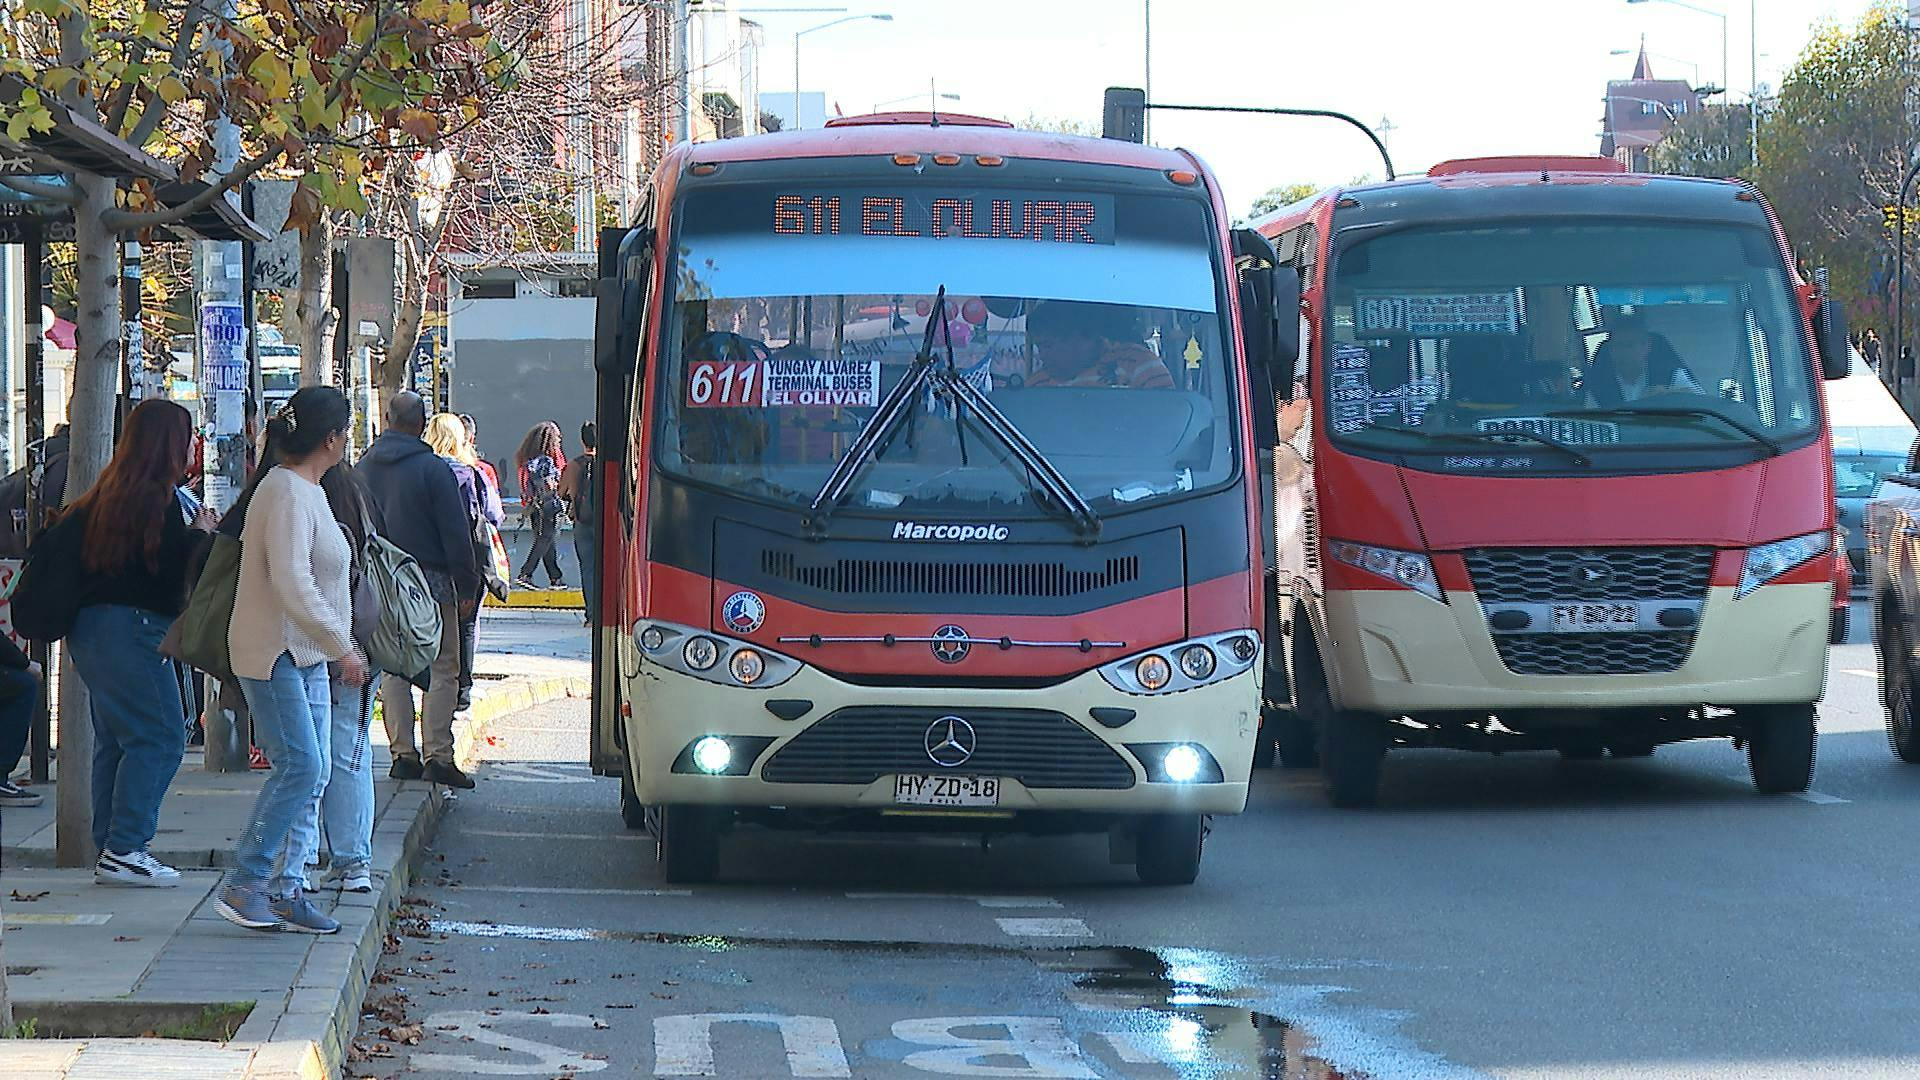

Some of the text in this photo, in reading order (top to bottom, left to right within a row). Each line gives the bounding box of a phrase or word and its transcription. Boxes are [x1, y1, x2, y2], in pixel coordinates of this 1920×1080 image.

[774, 195, 1095, 244] 611 EL OLIVAR
[1364, 299, 1404, 329] 607
[768, 360, 872, 376] YUNGAY ALVAREZ
[690, 363, 758, 404] 611
[768, 376, 872, 391] TERMINAL BUSES
[770, 391, 872, 405] EL OLIVAR
[892, 521, 1009, 541] Marcopolo
[408, 1010, 1103, 1080] BUS
